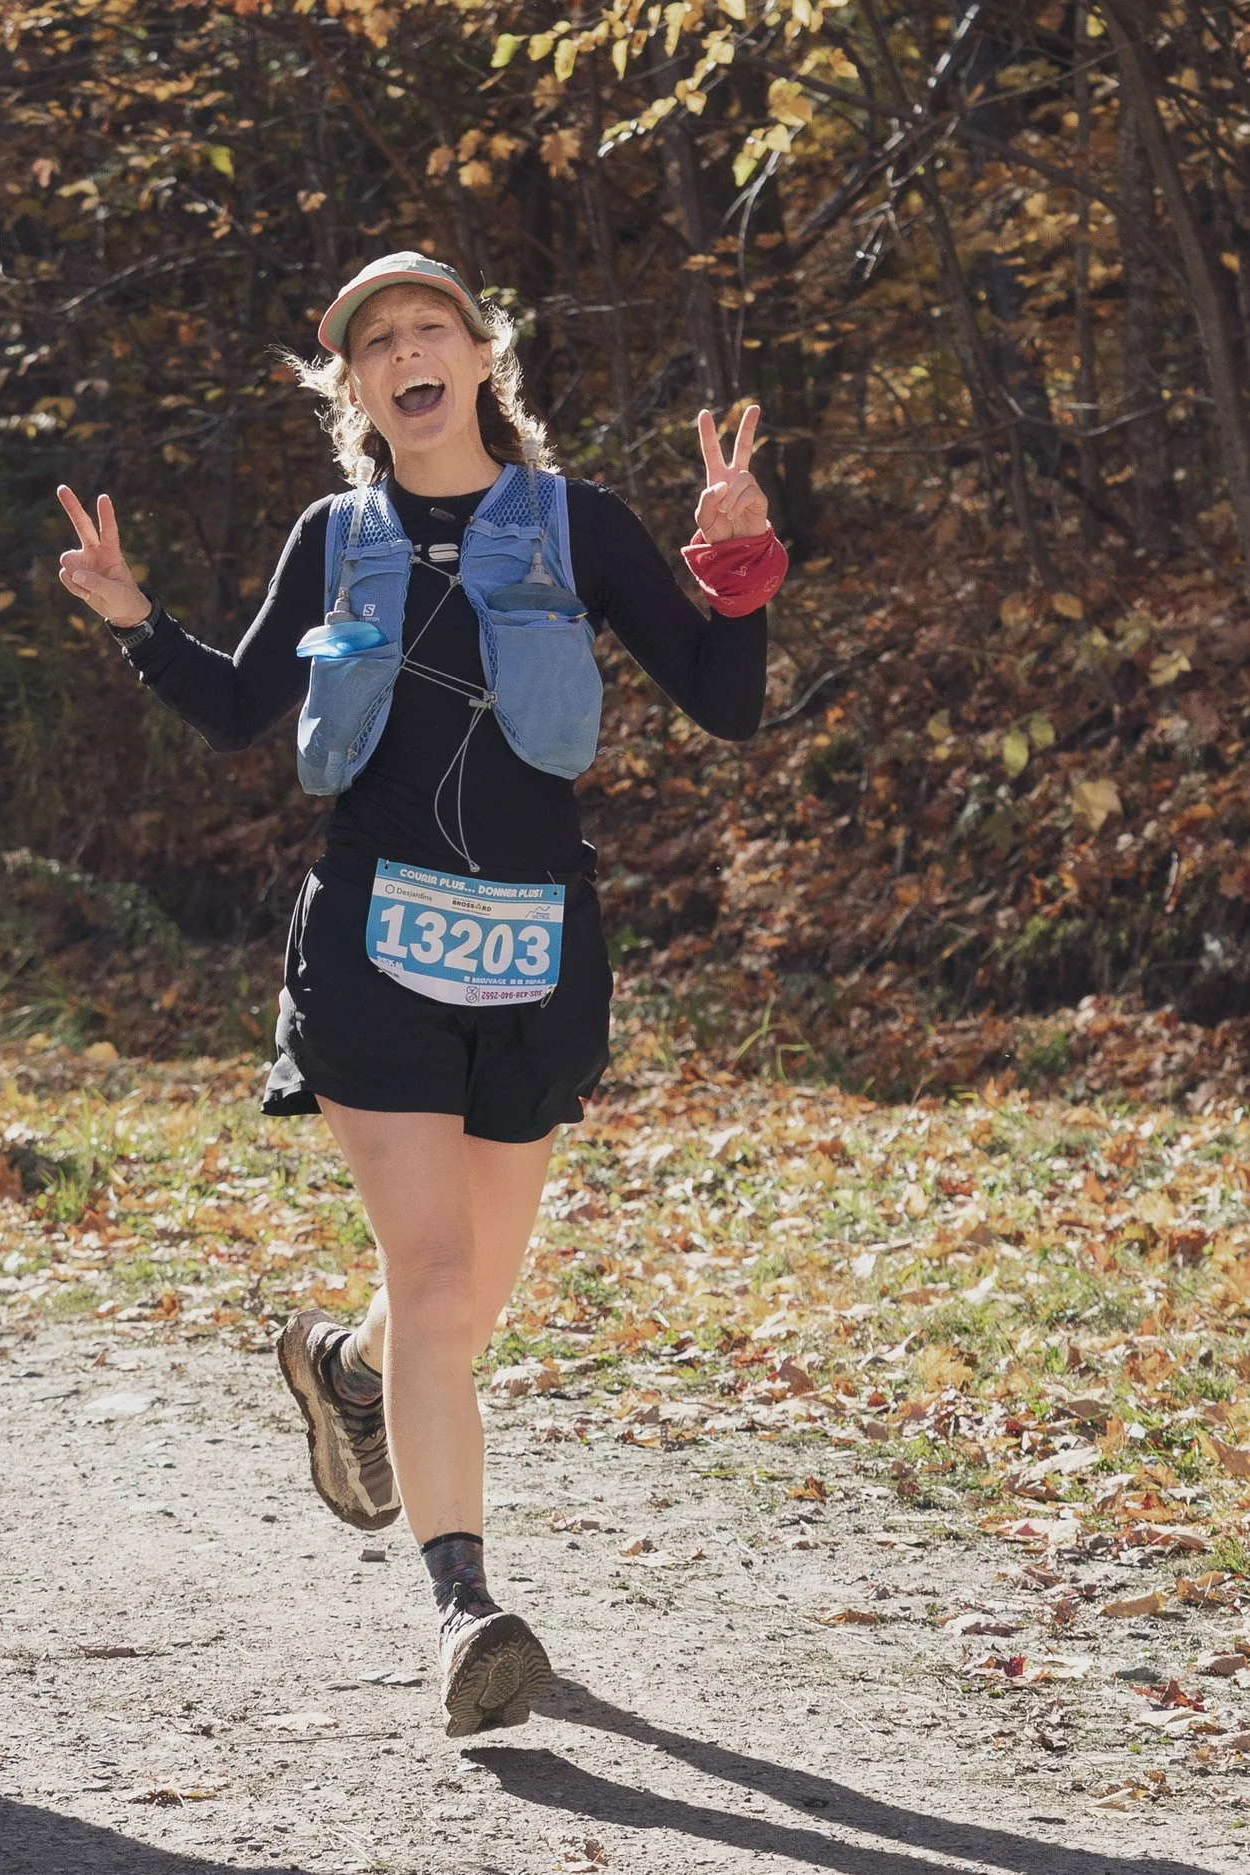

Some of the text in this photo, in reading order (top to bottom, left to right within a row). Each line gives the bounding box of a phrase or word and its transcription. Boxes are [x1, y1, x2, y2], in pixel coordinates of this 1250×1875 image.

[399, 868, 543, 898] COURIR PLUS... DONNER PLUS!
[396, 887, 432, 902] Desjardins
[452, 899, 492, 912] BROSSARD
[376, 904, 551, 977] 13203
